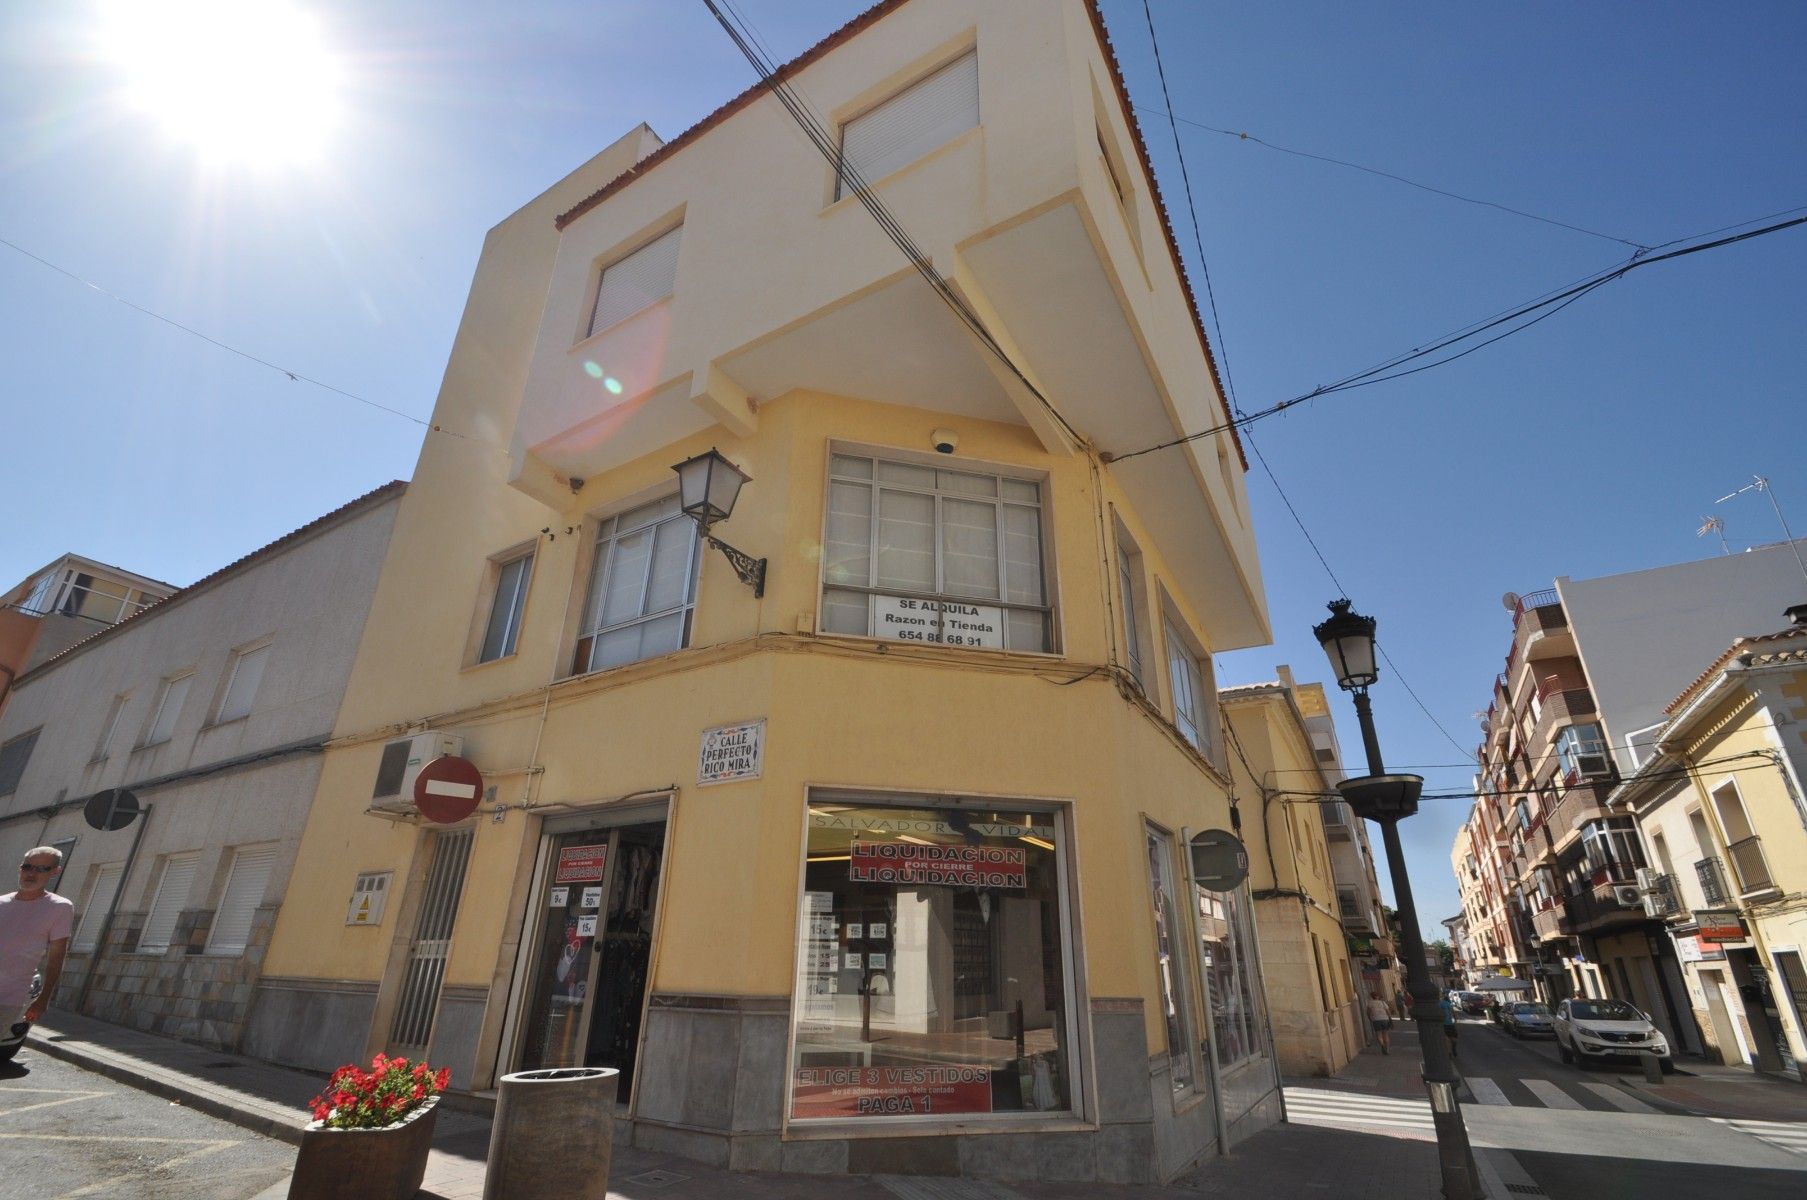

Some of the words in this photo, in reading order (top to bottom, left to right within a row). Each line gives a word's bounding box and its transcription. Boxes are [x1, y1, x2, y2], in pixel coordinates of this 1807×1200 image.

[900, 600, 916, 609] SE
[921, 602, 979, 616] ALQUILA
[885, 613, 926, 626] Razon
[949, 620, 993, 633] Tienda
[899, 630, 923, 640] 654
[947, 635, 963, 645] 68
[967, 637, 982, 646] 91
[721, 733, 748, 747] CALLE
[706, 745, 752, 761] PERFECTO
[704, 761, 725, 774] RICO
[728, 758, 751, 772] MIRA
[495, 806, 504, 820] 2
[814, 816, 946, 833] SALVADOR
[981, 823, 1049, 838] VIDAL
[853, 842, 1023, 864] LIQUIDACION
[904, 861, 928, 869] POR
[931, 863, 974, 871] CIERRE
[852, 867, 1025, 888] LIQUIDACION
[799, 1069, 860, 1086] ELIGE
[868, 1069, 880, 1085] 3
[886, 1068, 989, 1084] VESTIDOS
[858, 1096, 914, 1113] PAGA
[921, 1095, 931, 1112] 1
